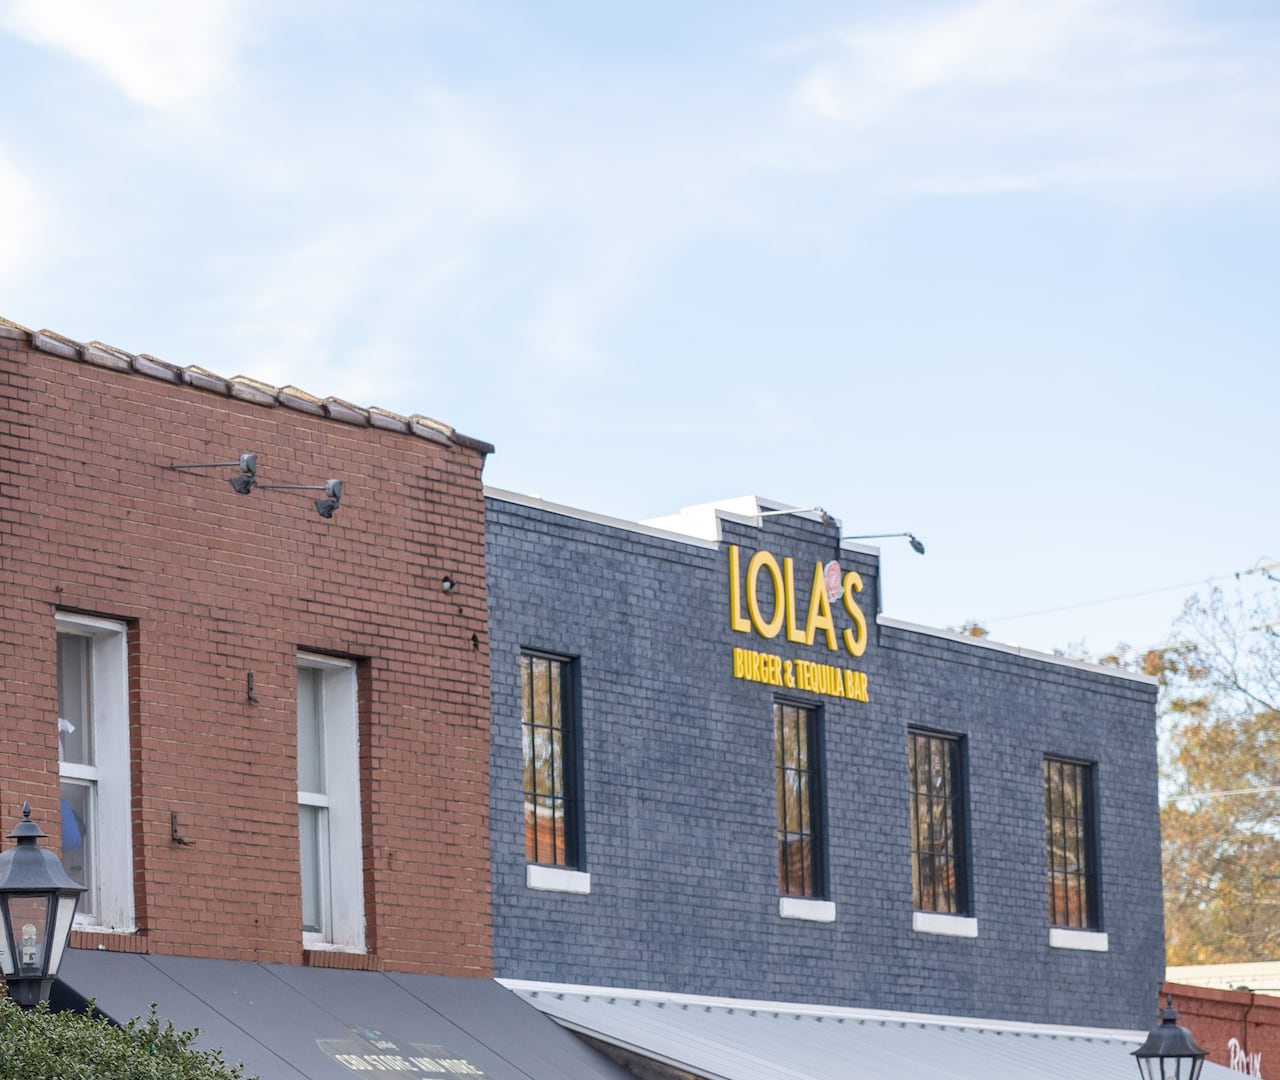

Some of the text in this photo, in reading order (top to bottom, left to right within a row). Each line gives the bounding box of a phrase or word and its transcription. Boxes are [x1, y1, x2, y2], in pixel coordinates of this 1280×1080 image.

[733, 647, 869, 702] BURGER & TEQUILA BAR
